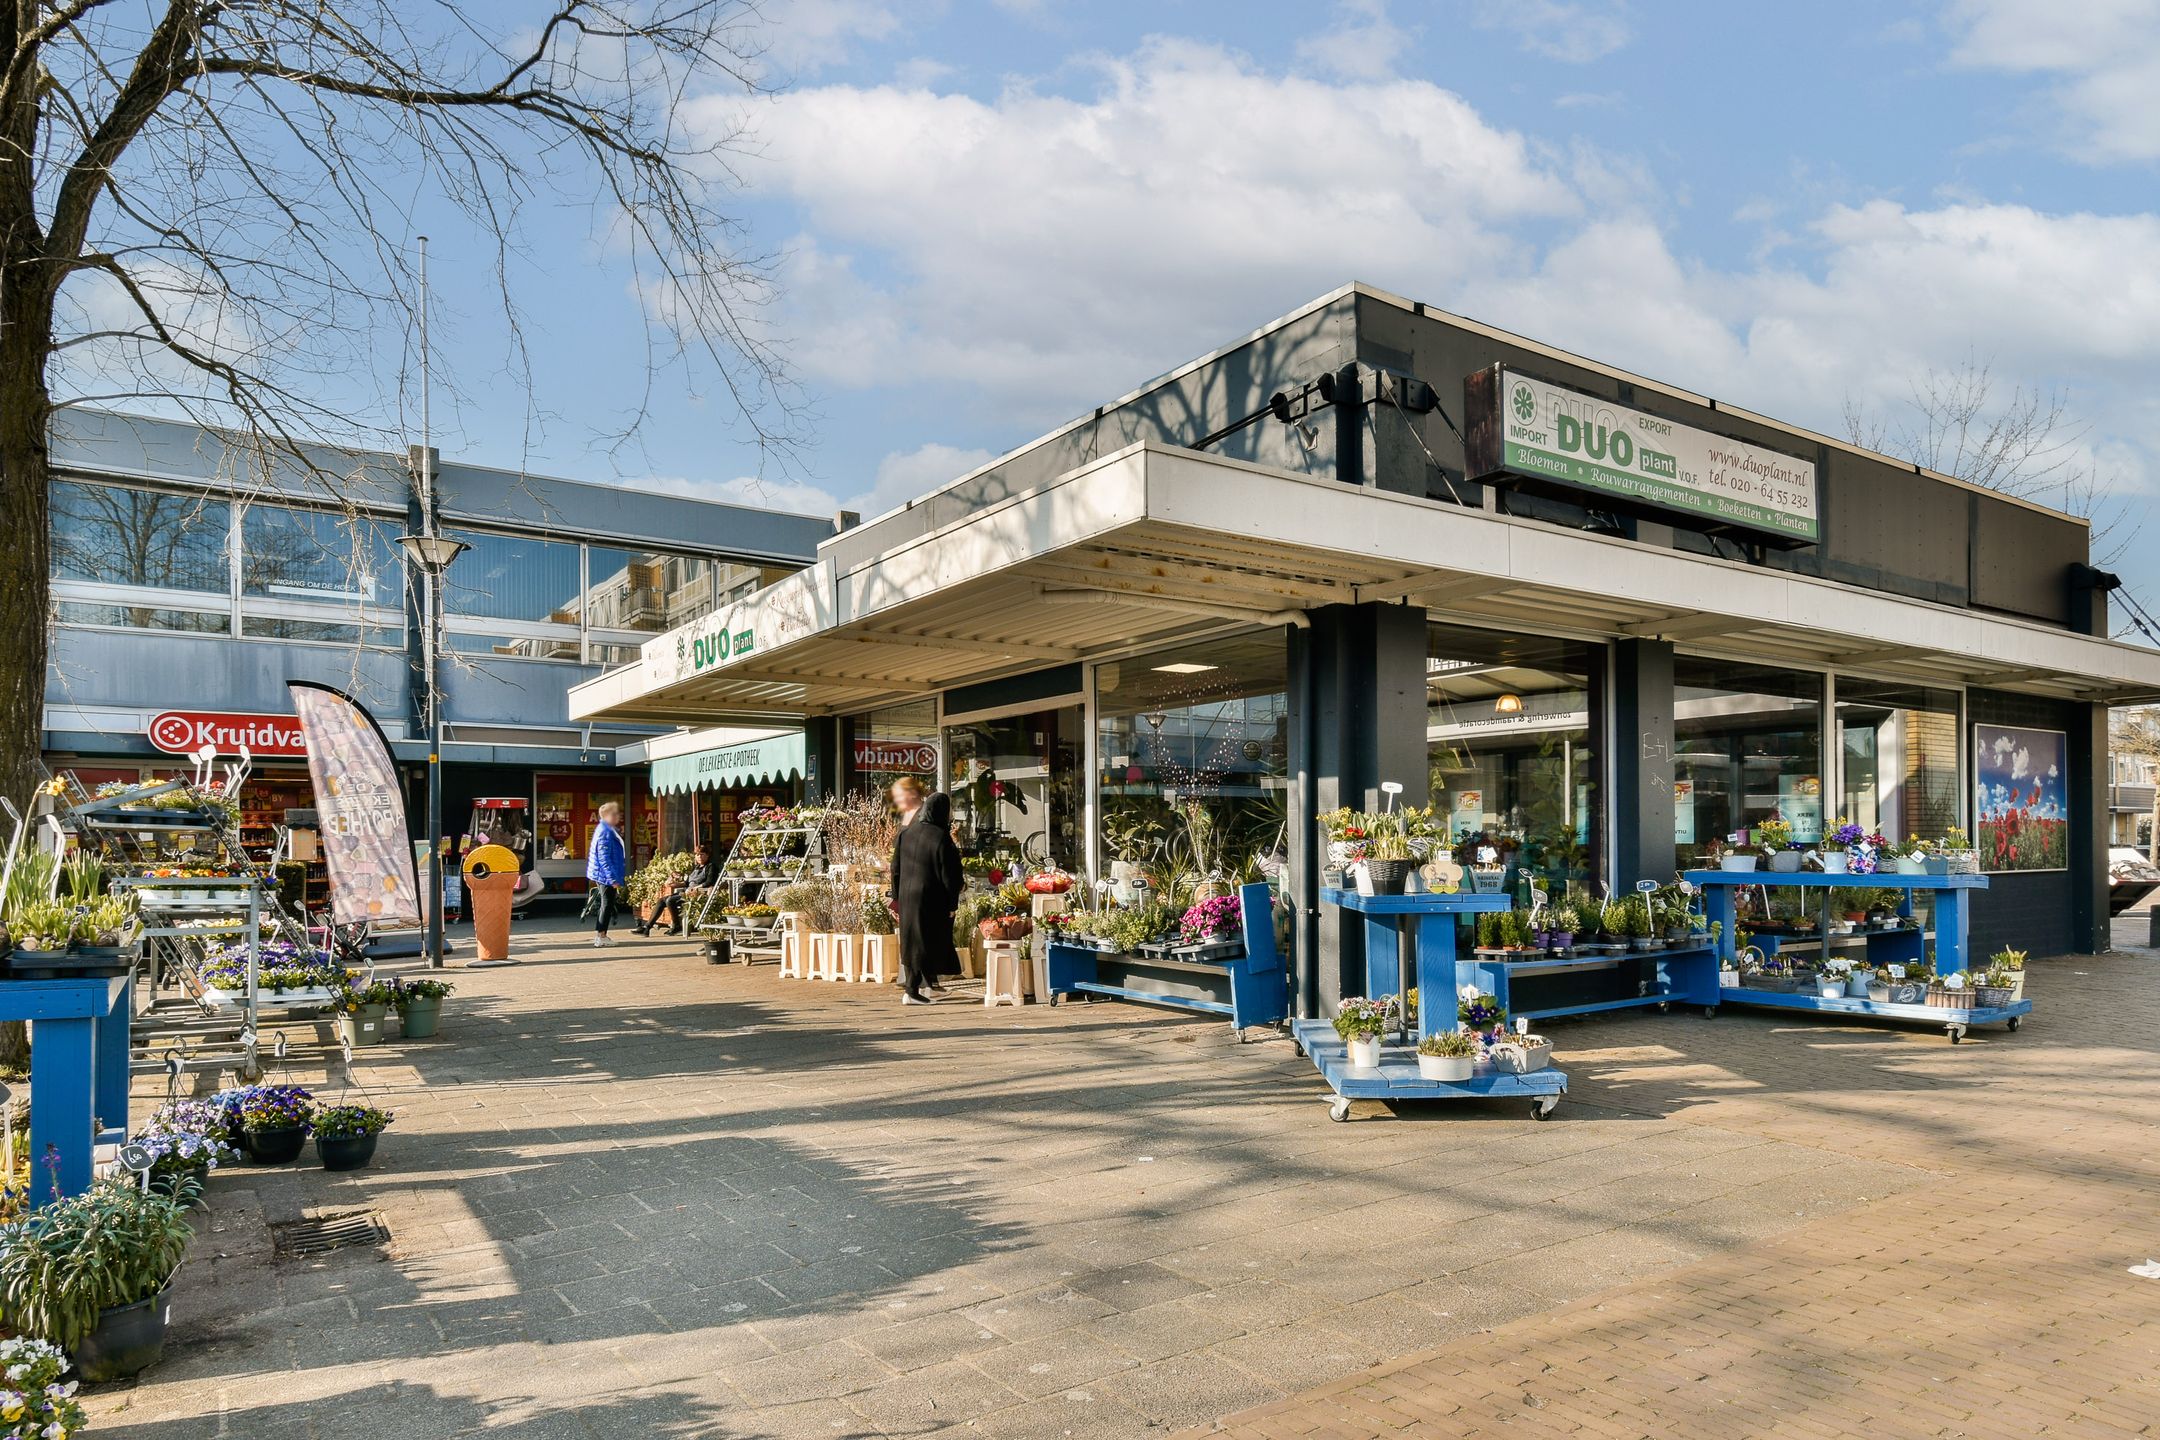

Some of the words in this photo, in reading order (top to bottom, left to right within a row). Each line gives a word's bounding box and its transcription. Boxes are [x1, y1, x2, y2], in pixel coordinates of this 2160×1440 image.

[1510, 425, 1548, 446] IMPORT
[1639, 417, 1672, 437] EXPORT
[1557, 413, 1633, 467] DUO
[1642, 453, 1675, 474] plant
[1708, 448, 1807, 488] www.duoplant.nl
[1679, 470, 1699, 486] V.O.F.
[1709, 468, 1726, 487] tel.
[1730, 477, 1750, 494] 020
[1760, 483, 1774, 503] 64
[1777, 488, 1789, 506] 55
[1791, 491, 1808, 509] 232
[1517, 449, 1569, 474] Bloemen
[1591, 467, 1700, 506] Rouwarrangementen
[1717, 499, 1761, 521] Boeketten
[1774, 513, 1808, 531] Planten
[274, 578, 305, 588] INGANG
[307, 581, 320, 589] OM
[321, 582, 333, 590] DE
[334, 584, 357, 592] HOEK
[694, 627, 730, 670] DUO
[735, 633, 753, 655] plant
[705, 752, 732, 772] LEKKERSTE
[733, 749, 761, 768] APOTHEEK
[699, 812, 734, 823] ACIE!
